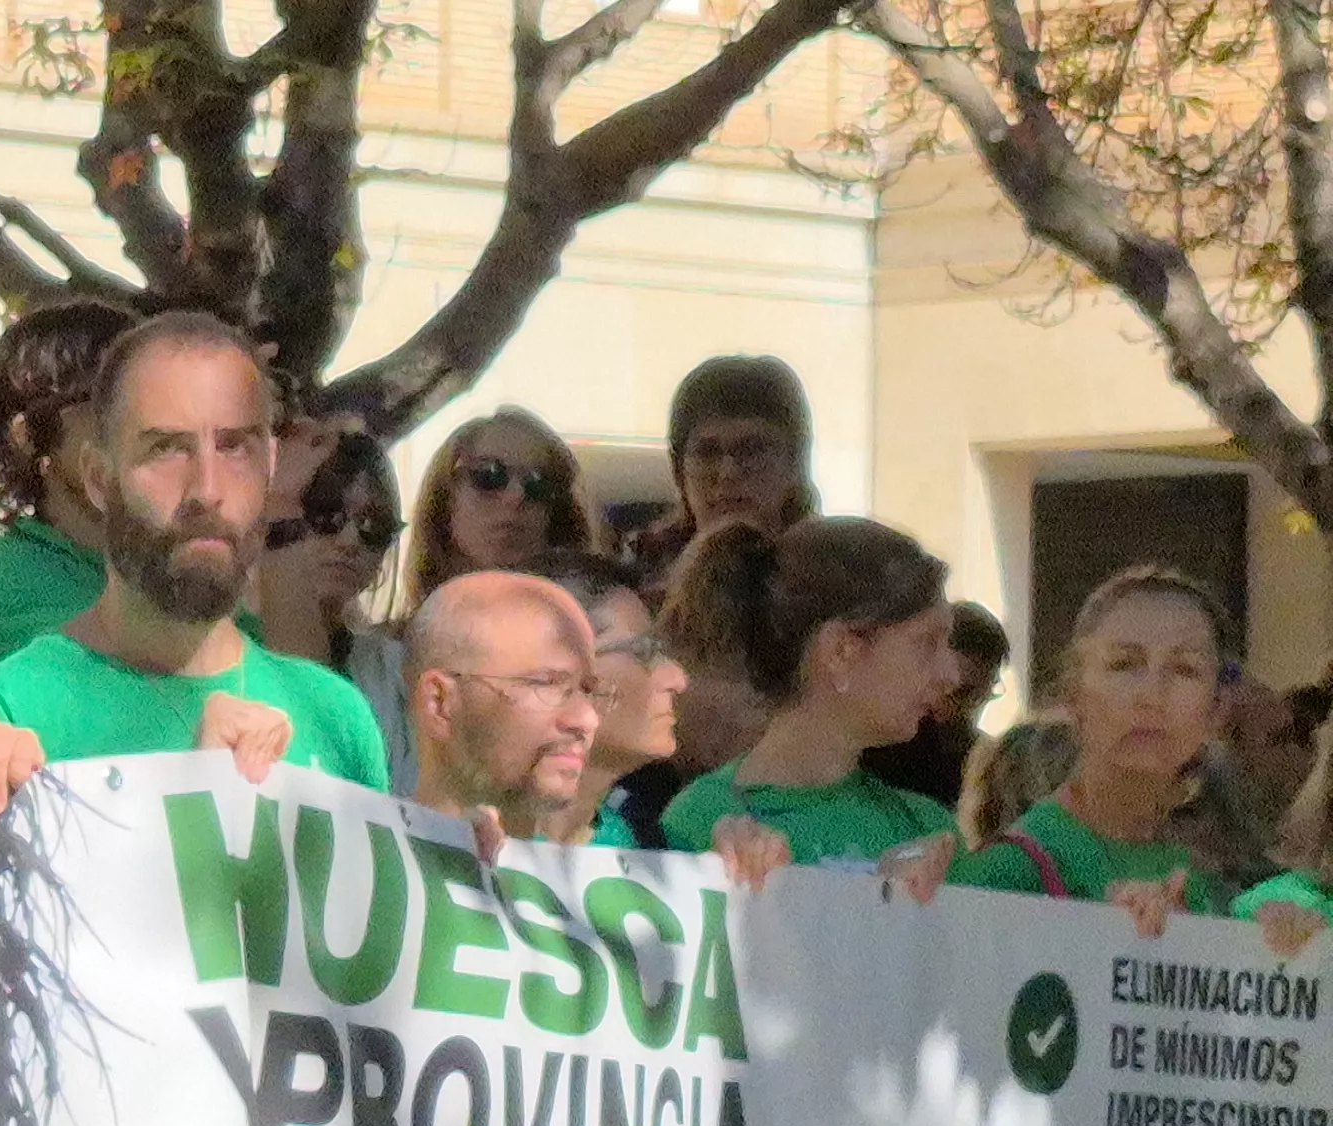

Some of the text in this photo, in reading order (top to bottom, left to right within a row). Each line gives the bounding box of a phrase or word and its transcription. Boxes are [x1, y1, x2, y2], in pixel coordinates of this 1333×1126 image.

[163, 790, 749, 1065] HUESCA
[1111, 955, 1321, 1021] ELIMINACIÓN
[1109, 1022, 1301, 1086] DE MÍNIMOS
